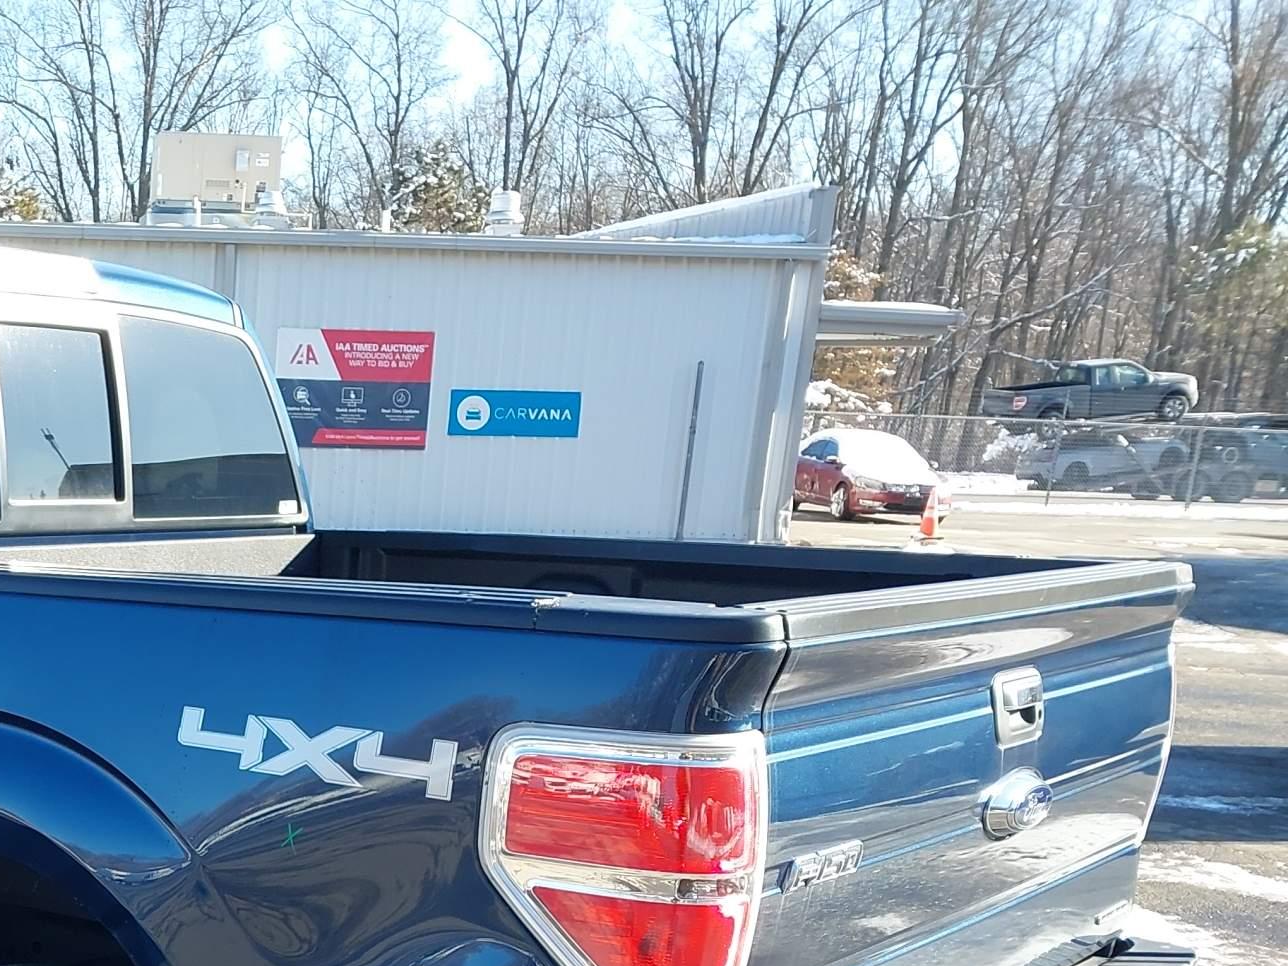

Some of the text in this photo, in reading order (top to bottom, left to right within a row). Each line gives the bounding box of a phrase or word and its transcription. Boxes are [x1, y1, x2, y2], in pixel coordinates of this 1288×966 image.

[335, 342, 351, 351] IAA
[353, 342, 378, 352] TIMED
[344, 352, 393, 360] INTRODUCING
[402, 353, 420, 361] NEW
[494, 407, 572, 421] CARVANA
